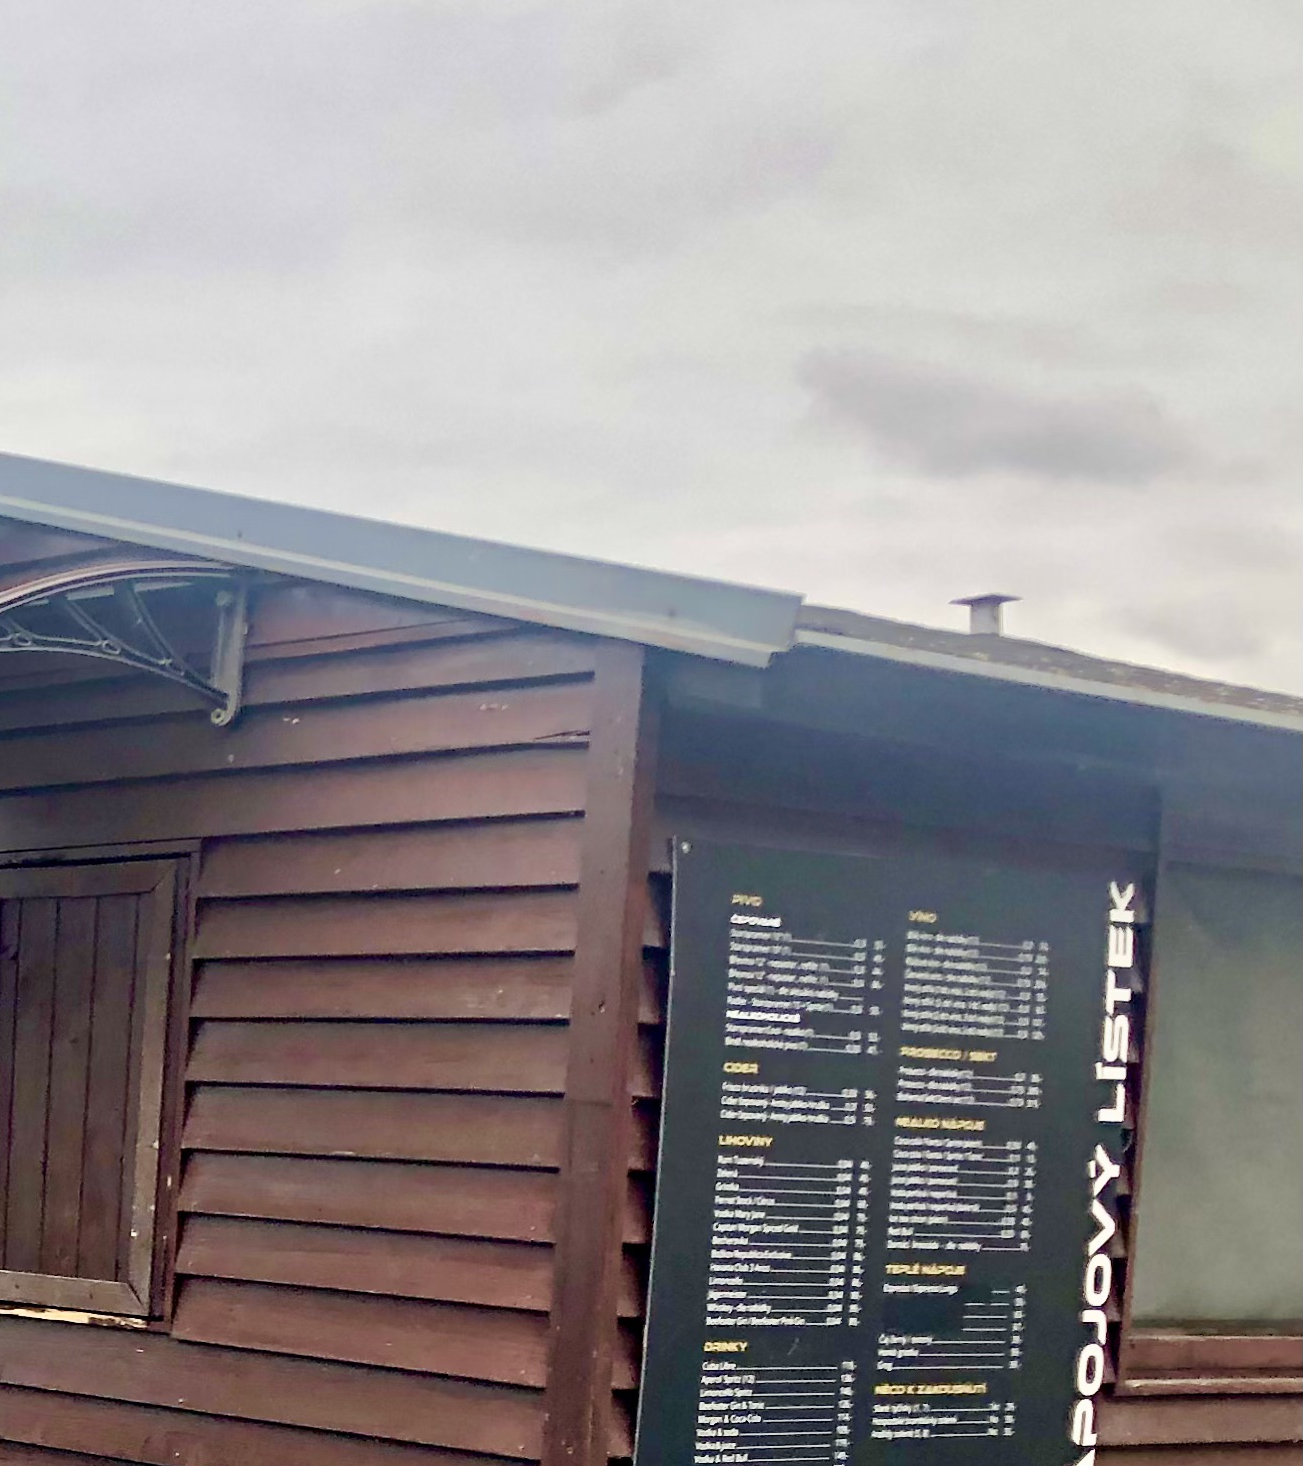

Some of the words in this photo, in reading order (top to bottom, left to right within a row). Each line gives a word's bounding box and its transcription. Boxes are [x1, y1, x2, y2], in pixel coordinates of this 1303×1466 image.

[1096, 881, 1135, 1123] LÍSTEK
[719, 1136, 773, 1147] LIHOVINY
[704, 1342, 748, 1351] DRINKY
